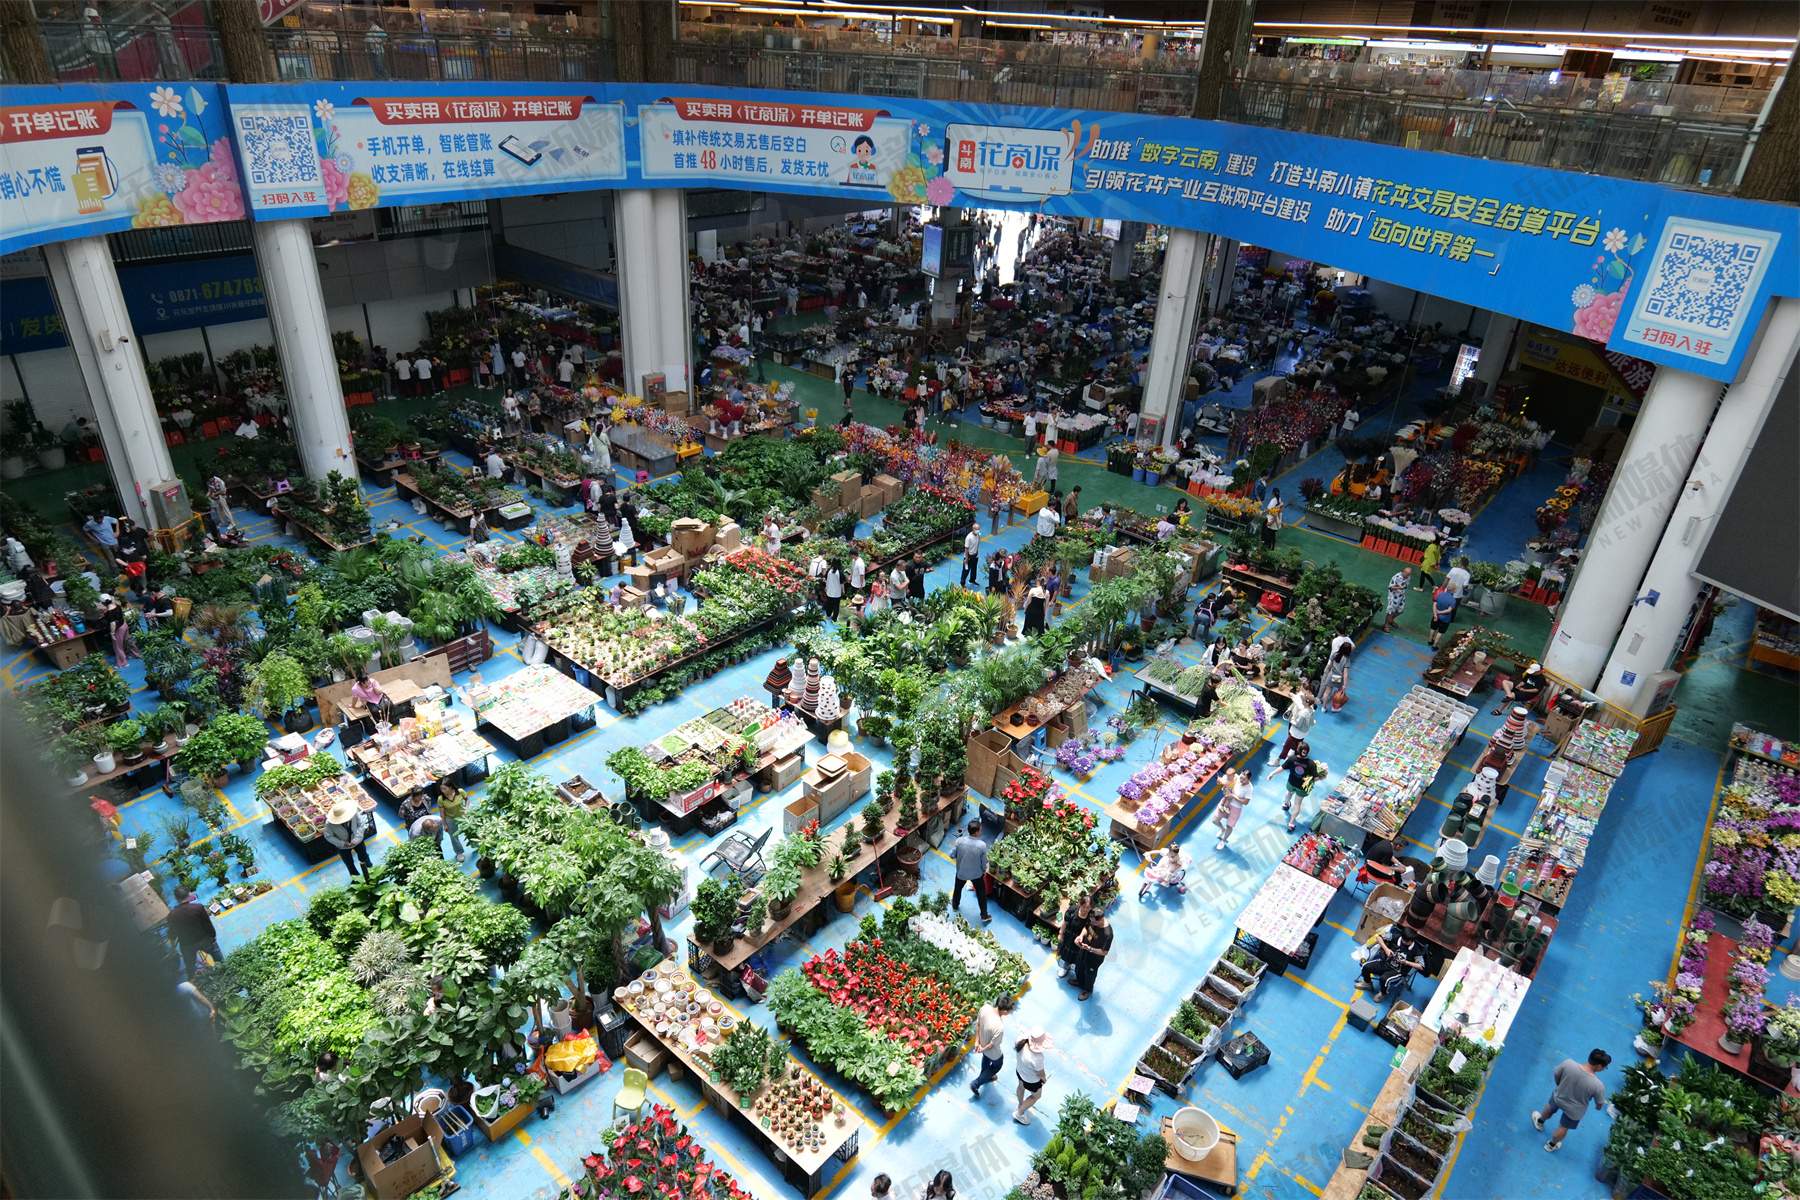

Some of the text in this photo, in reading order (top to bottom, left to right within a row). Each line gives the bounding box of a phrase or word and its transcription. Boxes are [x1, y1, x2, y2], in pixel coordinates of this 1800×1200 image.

[9, 108, 100, 135] 开单记账
[367, 133, 493, 157] 手机开单，智能管账
[672, 130, 806, 153] 填补传统交易无售后空白
[959, 142, 973, 170] 斗南
[978, 141, 1062, 172] 花商保
[0, 165, 66, 200] 销心不慌
[371, 158, 496, 184] 收支清晰，在线结算
[261, 191, 317, 206] 扫码入驻
[1085, 169, 1312, 225] 引领花卉产业互联网平台建设
[1641, 327, 1712, 356] 扫码入驻
[1553, 359, 1609, 385] 达远便利
